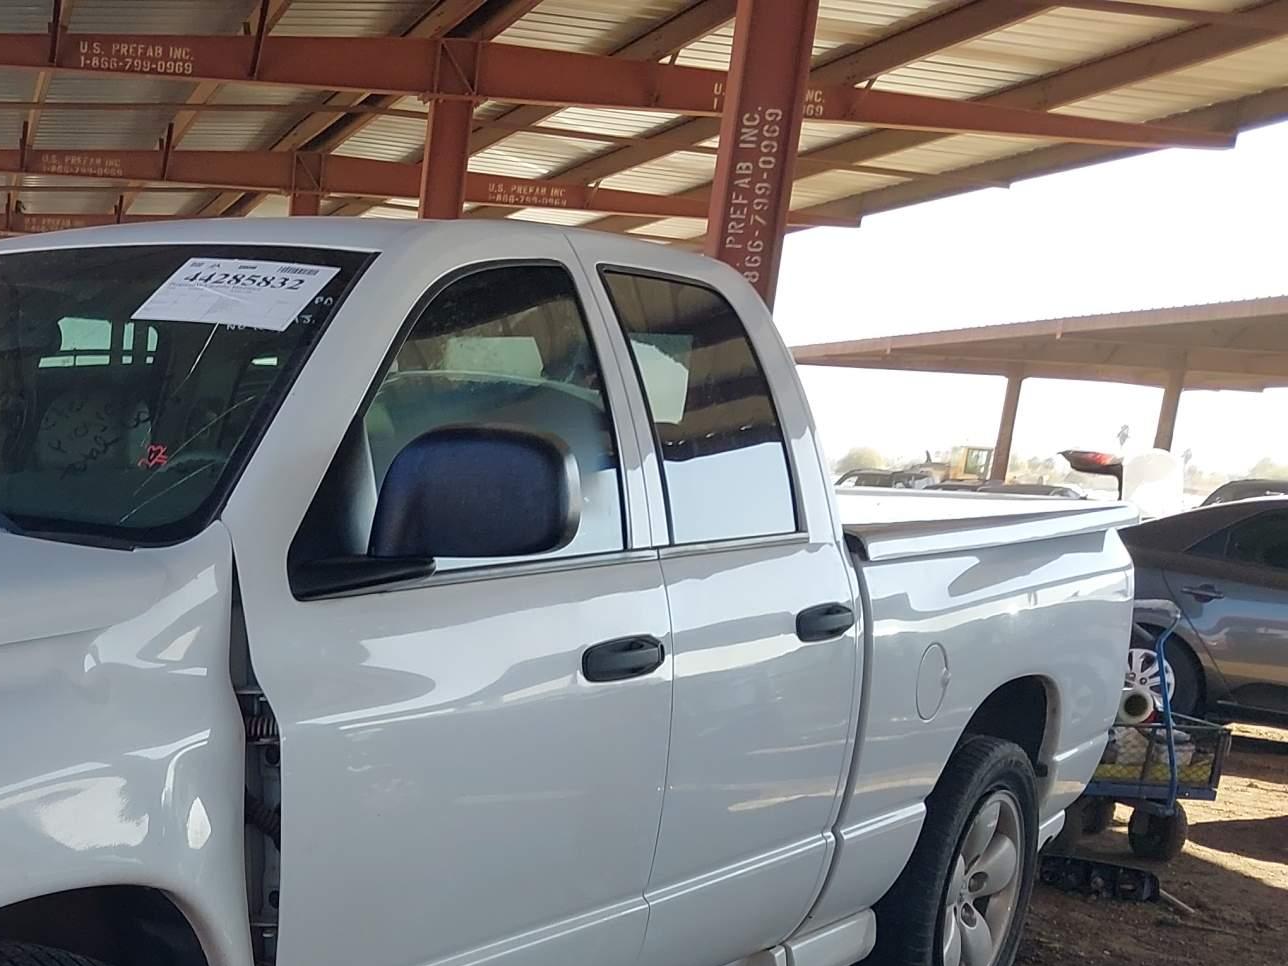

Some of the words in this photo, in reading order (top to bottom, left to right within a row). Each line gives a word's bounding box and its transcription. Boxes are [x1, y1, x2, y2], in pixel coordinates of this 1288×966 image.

[79, 40, 105, 55] U.S.
[112, 43, 163, 58] PREFAB
[169, 47, 194, 60] INC.
[80, 55, 193, 74] 1-866-799-0969
[725, 161, 753, 249] PREFAB
[739, 106, 762, 149] INC.
[184, 271, 305, 290] 44285832
